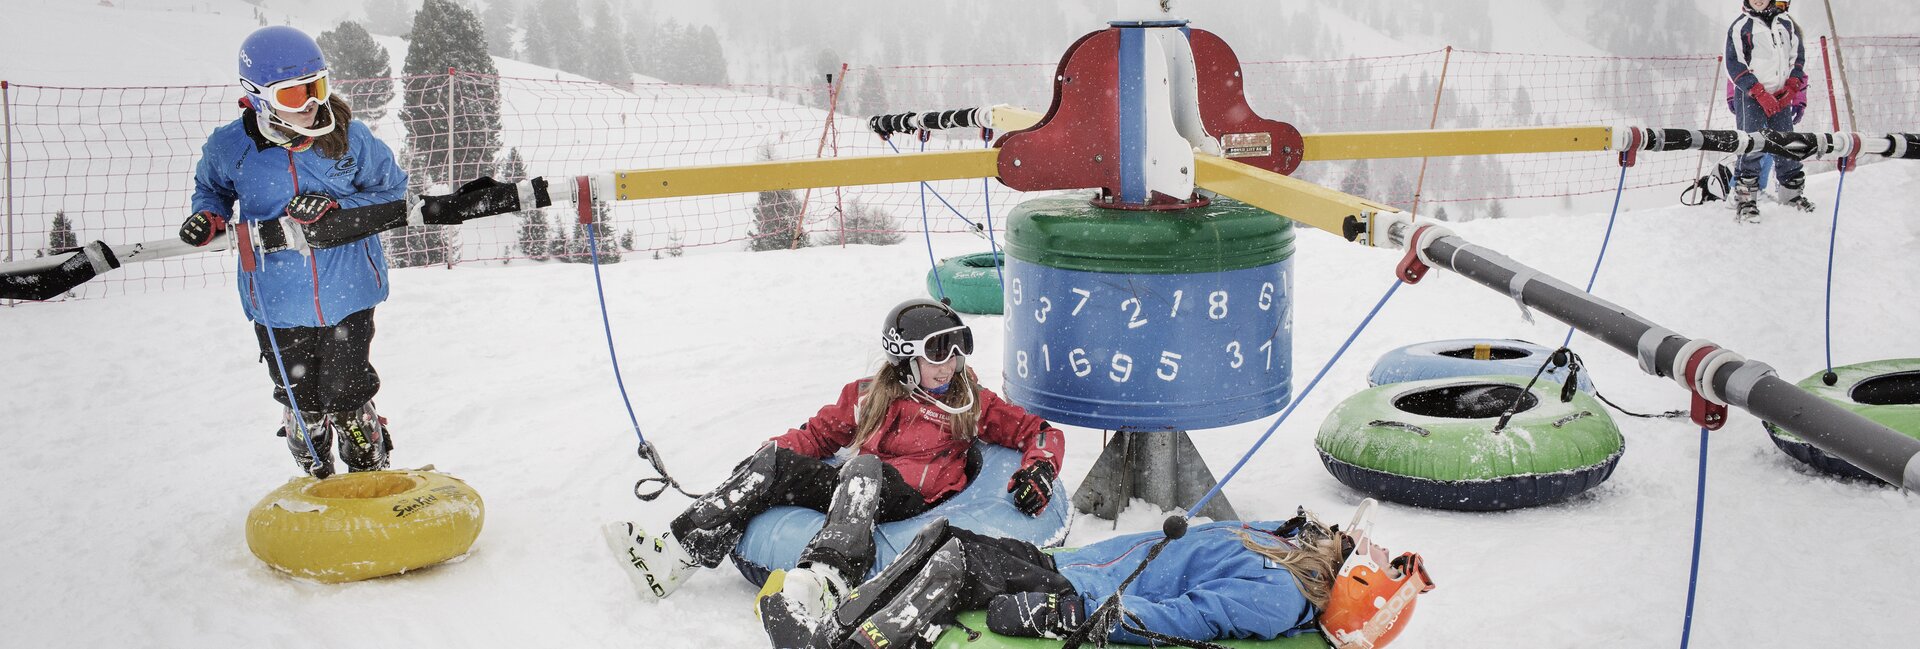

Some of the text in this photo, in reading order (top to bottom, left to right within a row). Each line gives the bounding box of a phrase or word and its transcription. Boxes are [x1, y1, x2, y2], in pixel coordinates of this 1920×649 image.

[1012, 277, 1022, 306] 9
[1071, 287, 1091, 317] 7
[1170, 289, 1183, 318] 1
[1208, 290, 1229, 320] 8
[1258, 281, 1275, 311] 6
[1034, 296, 1052, 324] 3
[1120, 297, 1148, 329] 2
[1016, 350, 1029, 379] 8
[1042, 343, 1051, 372] 1
[1068, 347, 1092, 378] 6
[1109, 353, 1133, 383] 9
[1156, 350, 1182, 382] 5
[1226, 340, 1243, 369] 3
[628, 546, 666, 598] HEAD
[860, 618, 889, 648] EKI
